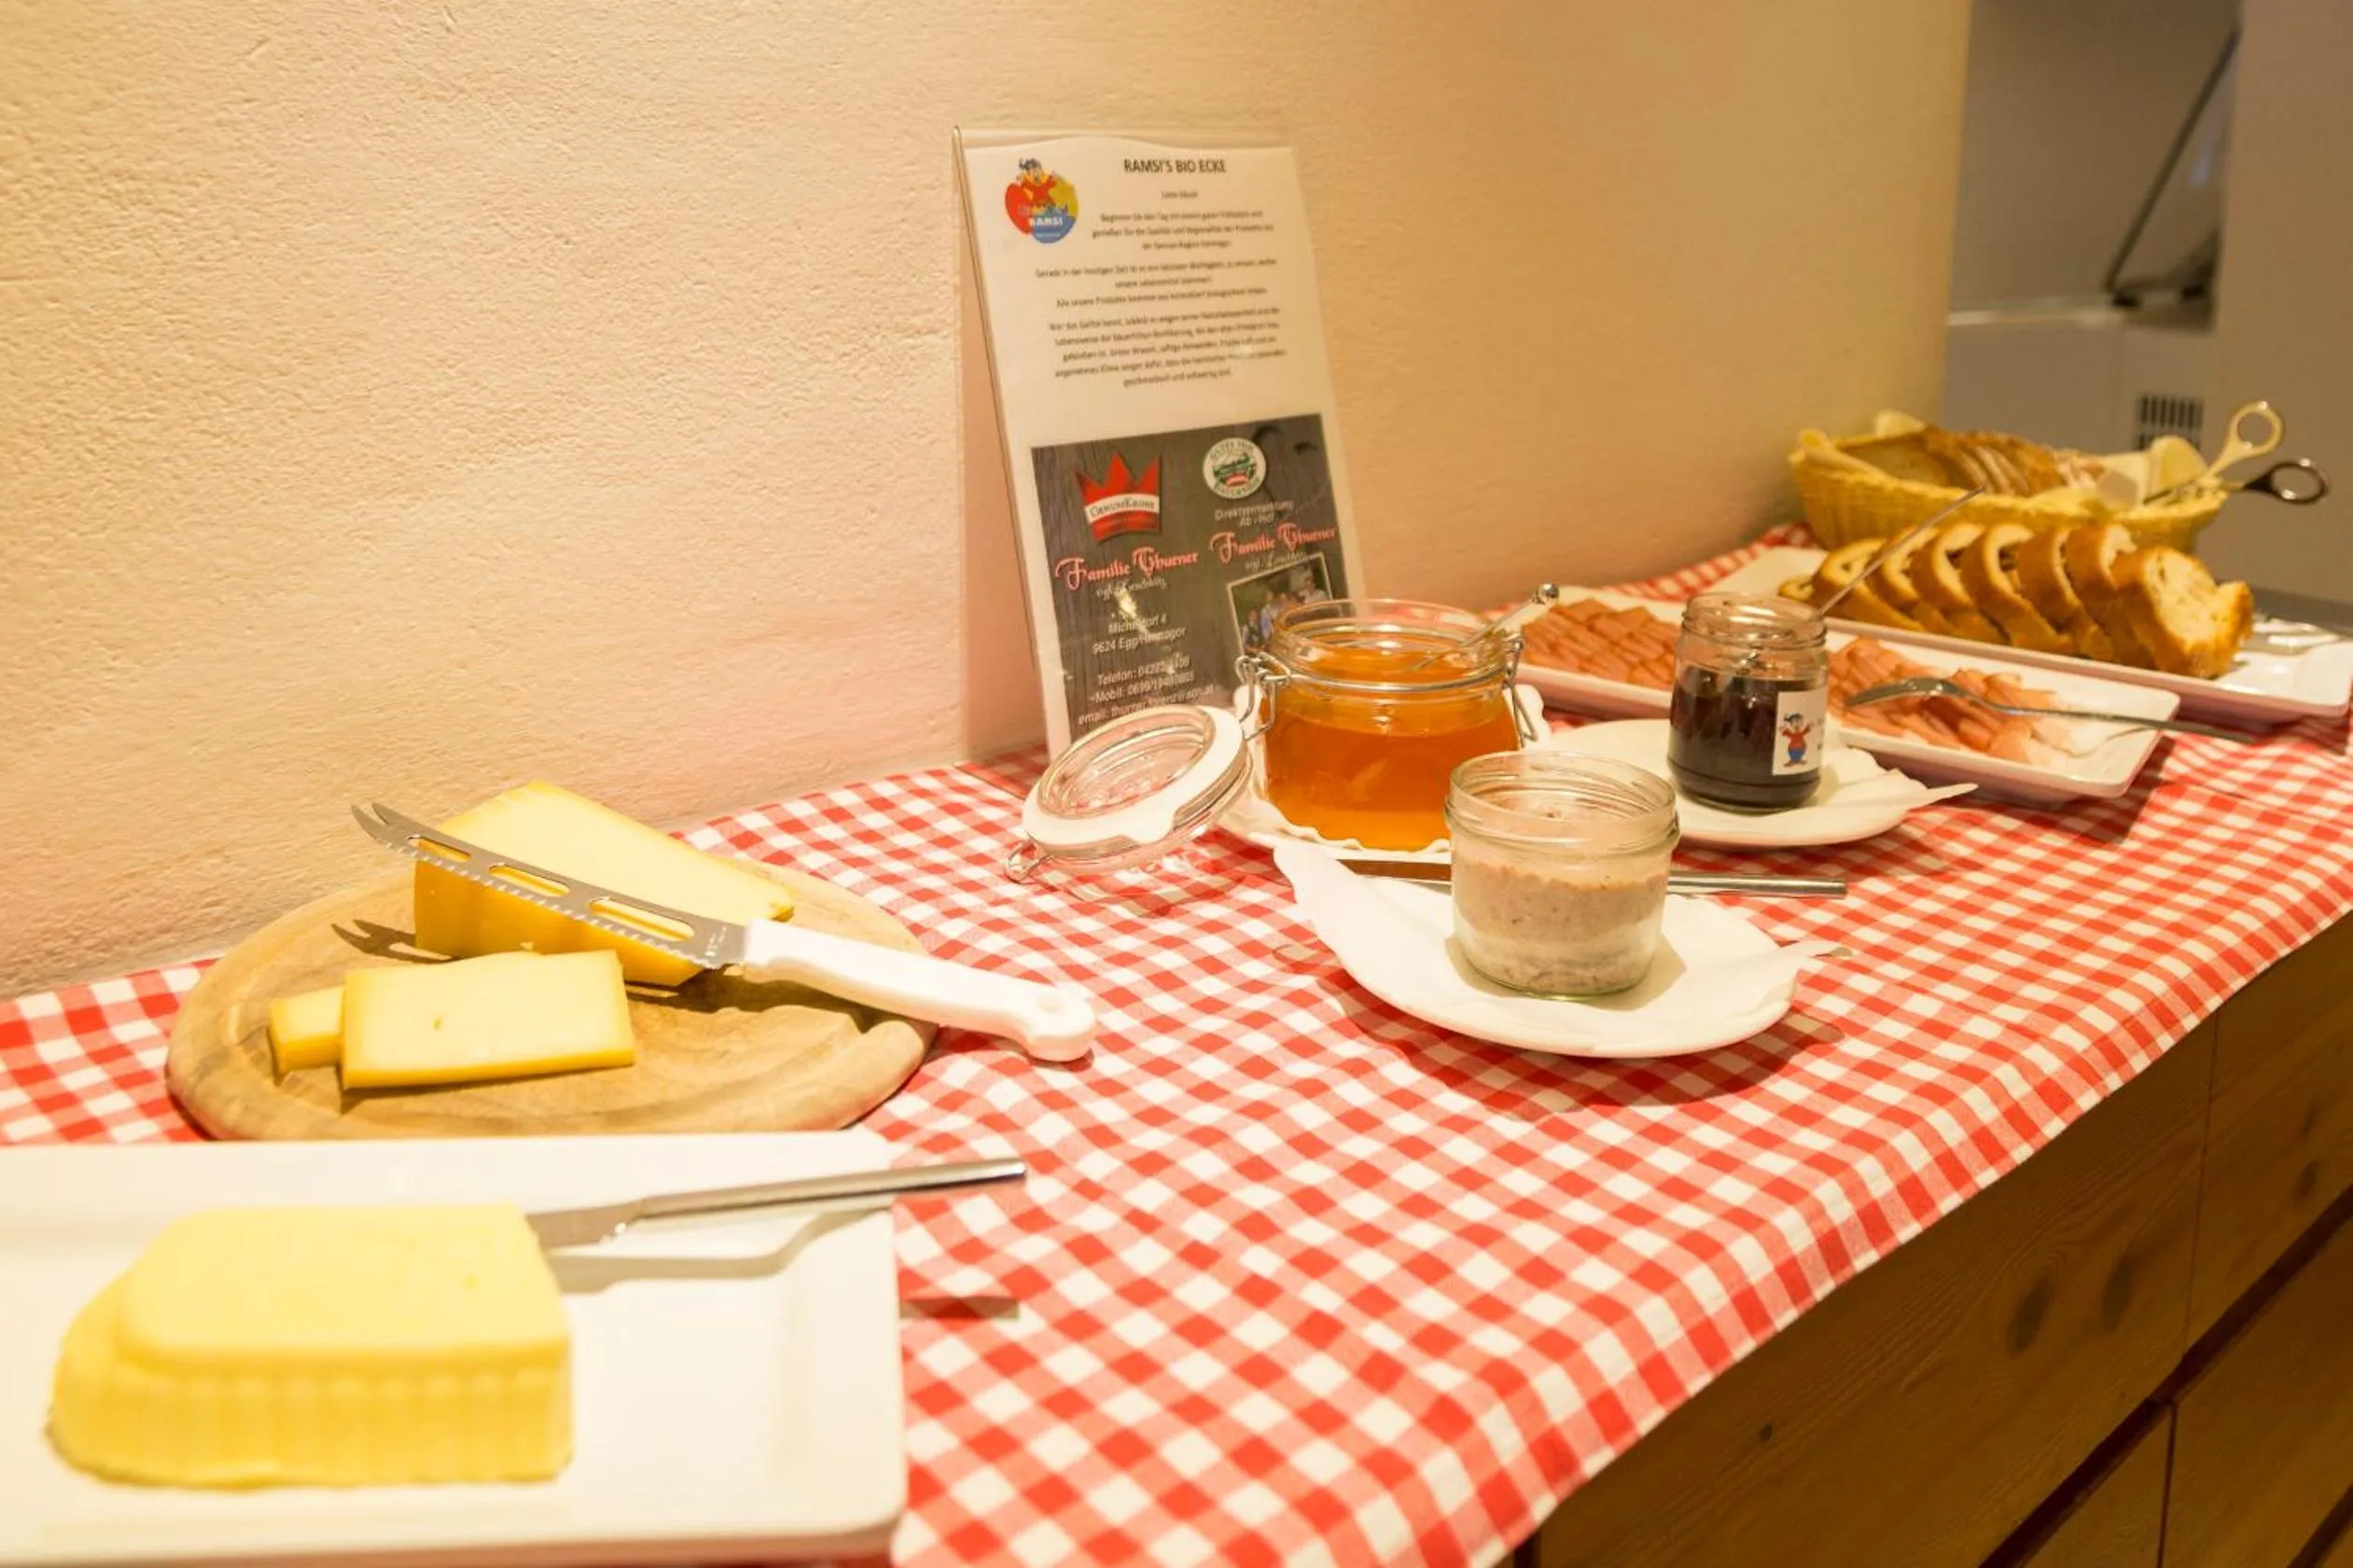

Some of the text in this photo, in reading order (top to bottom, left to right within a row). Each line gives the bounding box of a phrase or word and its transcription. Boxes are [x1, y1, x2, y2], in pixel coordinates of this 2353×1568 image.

[1123, 159, 1227, 173] RAMSI'S BIO ECKE
[1209, 531, 1276, 563] Familie
[1055, 557, 1131, 590] Familie
